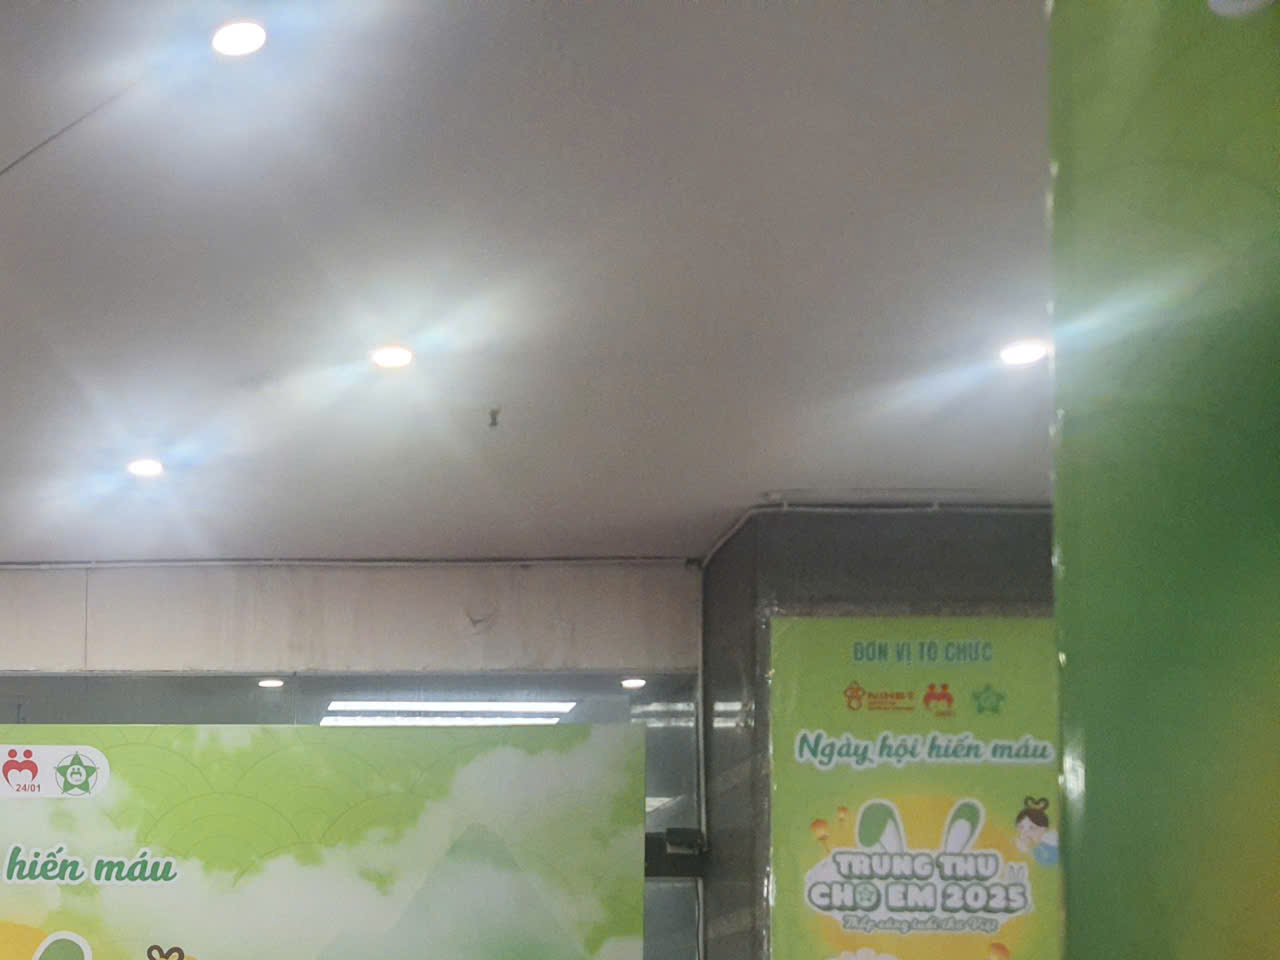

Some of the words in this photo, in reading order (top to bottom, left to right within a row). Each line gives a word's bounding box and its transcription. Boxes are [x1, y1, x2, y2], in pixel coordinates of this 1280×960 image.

[798, 733, 872, 766] Ngày
[878, 734, 920, 764] hội
[928, 735, 982, 759] hiến
[991, 738, 1052, 760] máu
[16, 784, 41, 792] 24/01
[6, 845, 84, 881] hiến
[94, 850, 177, 882] máu
[832, 851, 934, 880] TRUNG
[935, 852, 1000, 881] THU
[808, 881, 881, 911] CHO
[885, 882, 937, 912] EM
[941, 882, 1028, 913] 2025
